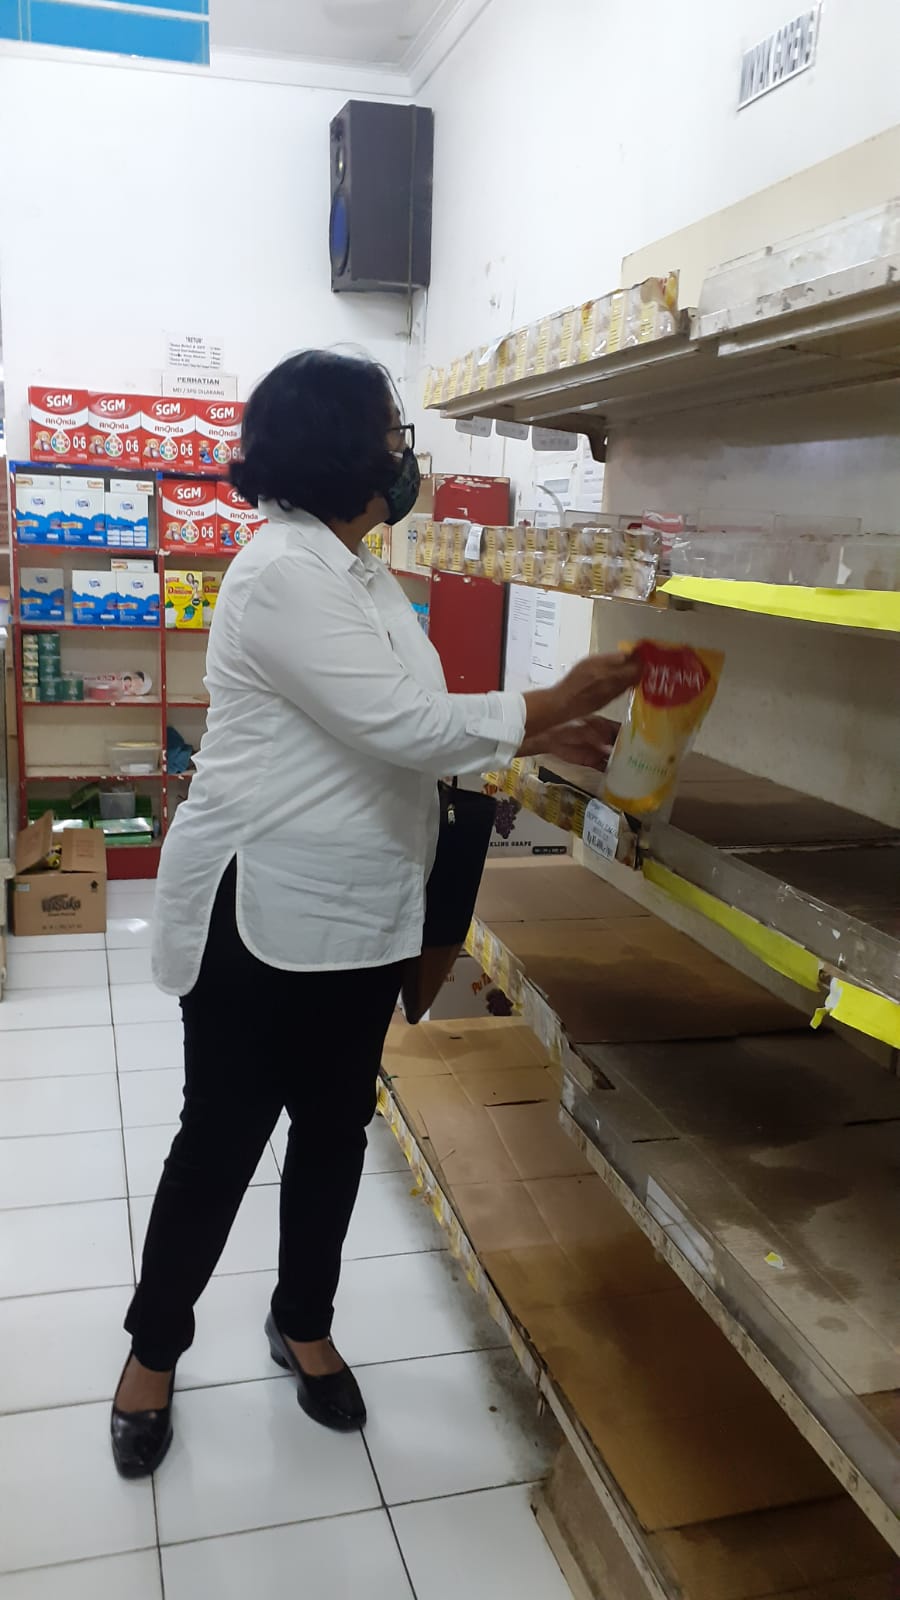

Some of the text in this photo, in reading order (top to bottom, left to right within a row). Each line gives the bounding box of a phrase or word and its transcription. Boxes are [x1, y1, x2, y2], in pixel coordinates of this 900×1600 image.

[177, 376, 220, 386] PERHATIAN
[46, 394, 73, 408] SGM
[100, 399, 126, 412] SGM
[156, 403, 181, 416] SGM
[210, 407, 235, 420] SGM
[177, 487, 202, 500] SGM
